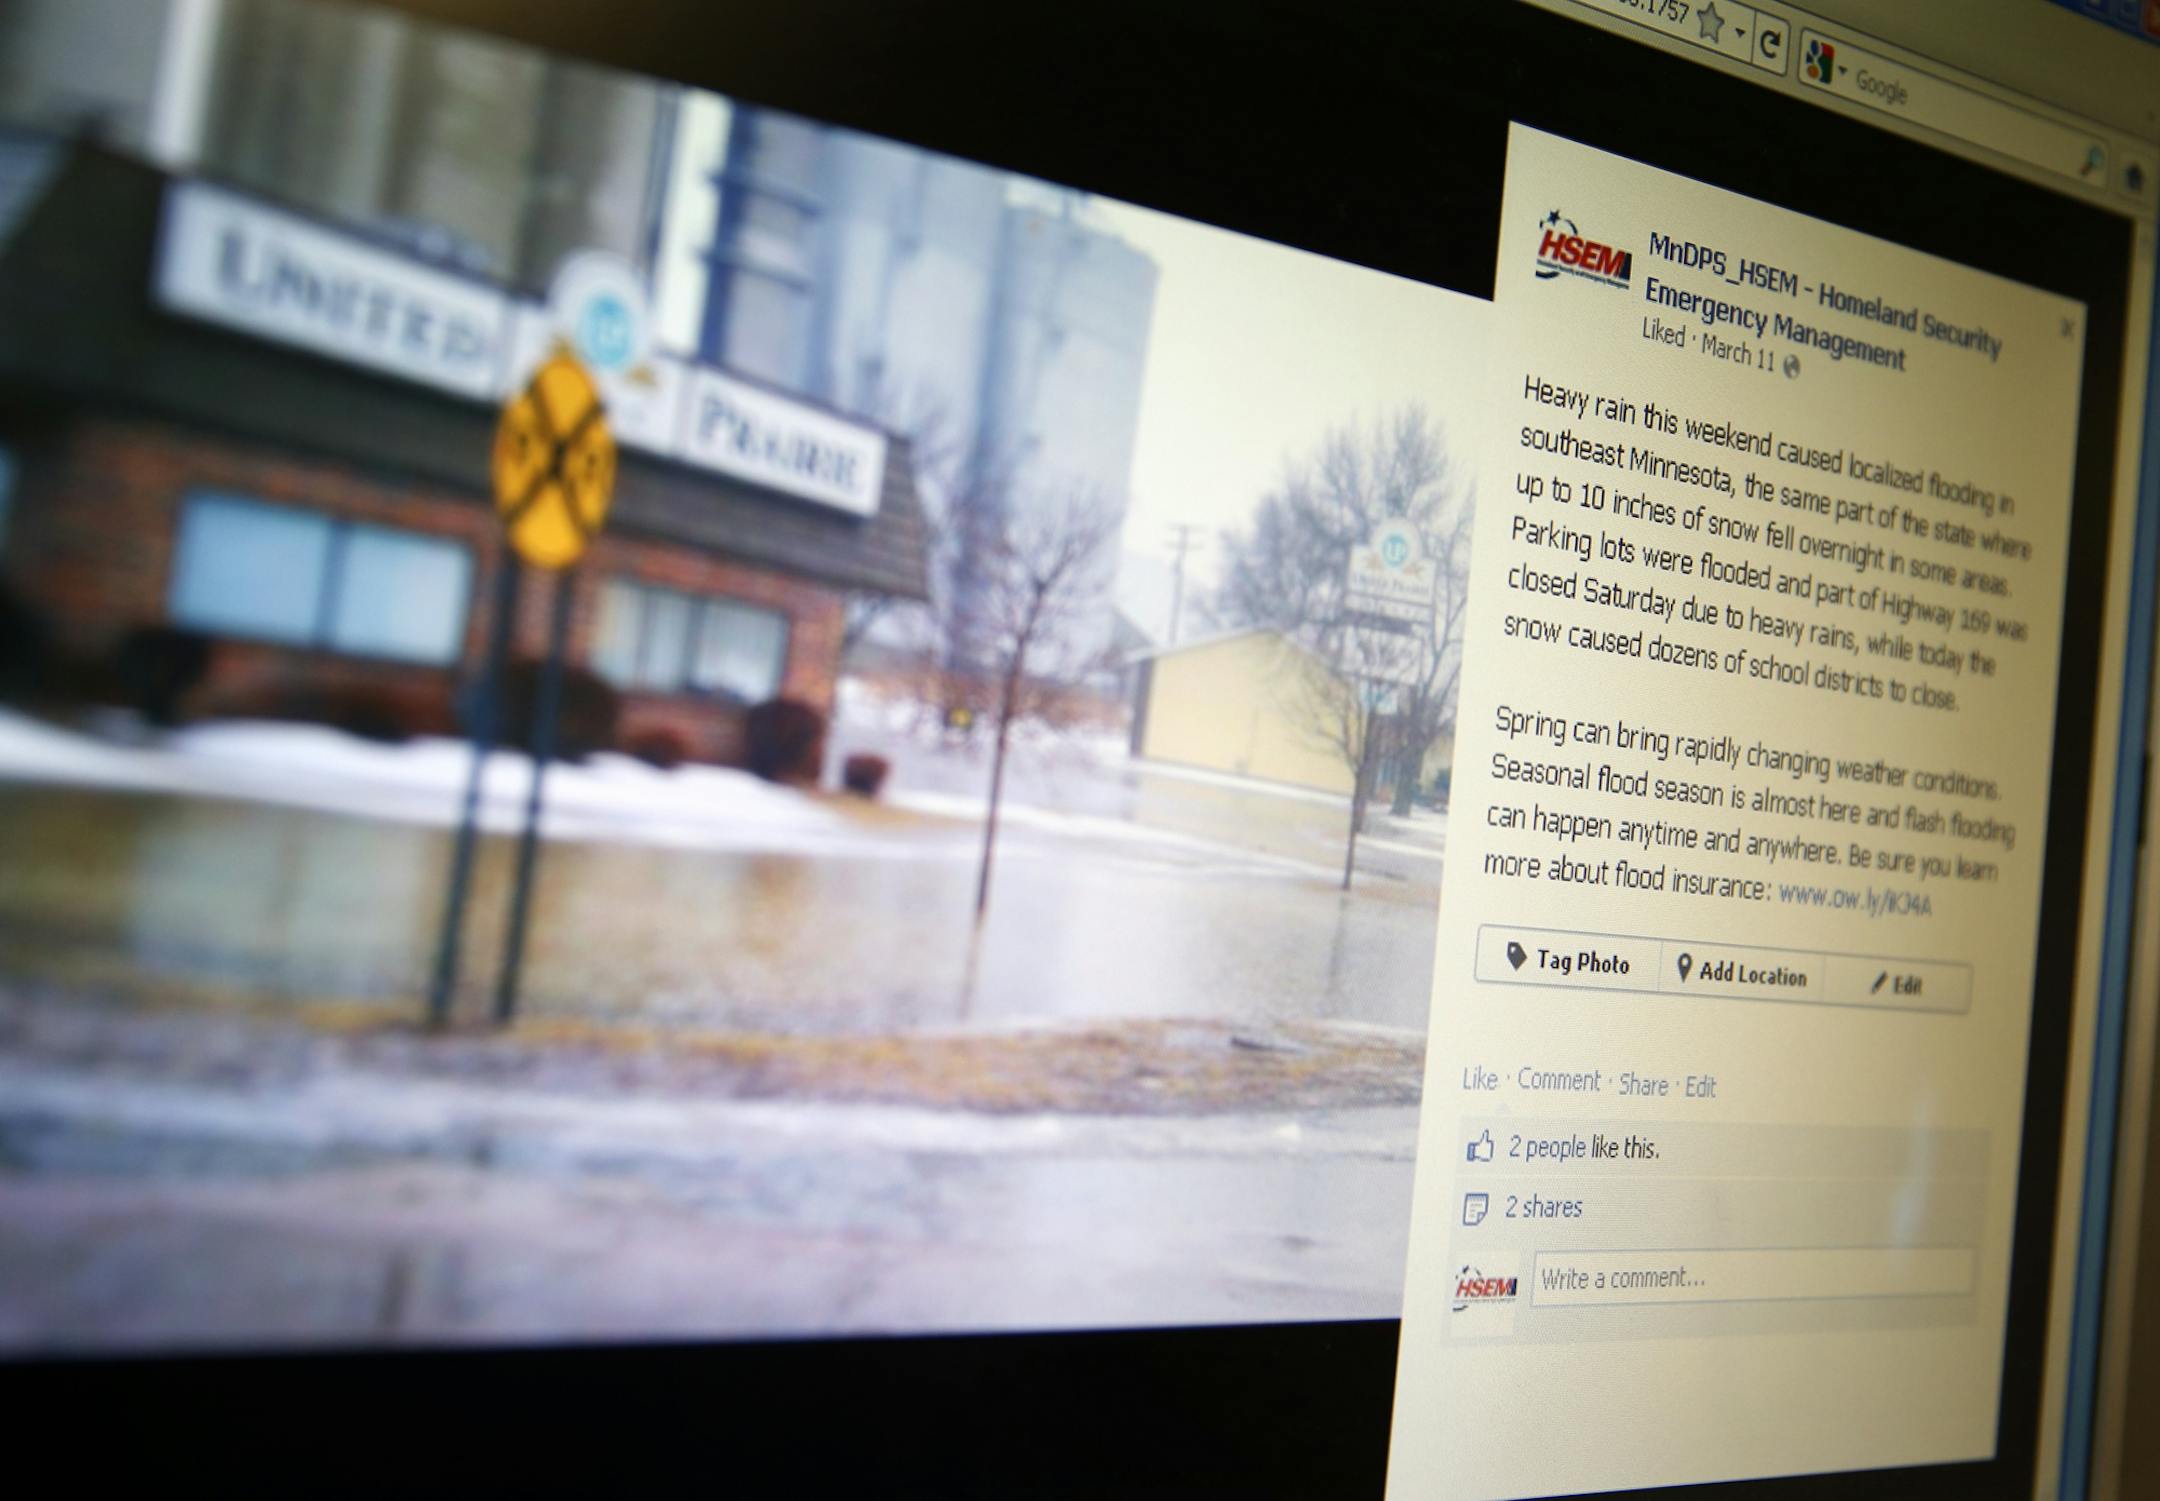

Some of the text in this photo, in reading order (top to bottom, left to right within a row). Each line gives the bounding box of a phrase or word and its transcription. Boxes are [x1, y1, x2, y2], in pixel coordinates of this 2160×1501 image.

[1856, 69, 1908, 104] Google
[1539, 229, 1626, 278] HSEM
[1646, 277, 1906, 371] Emergency Management
[1650, 232, 1798, 297] MnDPS_HSEM
[1819, 283, 1918, 332] Homeland
[1923, 314, 2002, 362] Security
[1643, 317, 1773, 372] Liked March 11
[1525, 375, 2015, 517] Heavy rain this weekend caused localized flooding in
[1521, 427, 2032, 560] southeast Minnesota, the same part of the state where
[1517, 474, 1543, 503] up
[1552, 477, 1571, 503] to
[1581, 484, 1605, 510] 10
[1614, 490, 1676, 525] inches
[1683, 506, 1706, 531] of
[1709, 516, 1759, 542] snow
[1767, 521, 1794, 550] fell
[1800, 535, 1884, 573] overnight
[1890, 554, 1904, 573] in
[1910, 559, 1956, 585] some
[1513, 516, 2027, 641] Parking lots were flooded and part of Highway 169 was
[1509, 563, 1996, 676] closed Saturday due to heavy rains, while today the
[1504, 616, 1959, 712] snow caused dozens of school districts to close.
[1496, 706, 1566, 747] Spring
[1574, 722, 1610, 745] can
[1617, 721, 1669, 761] bring
[1676, 736, 1741, 770] rapidly
[1747, 742, 1830, 783] changing
[1837, 761, 1908, 786] weather
[1492, 753, 2016, 850] Seasonal flood season is almost here and flash flooding
[1488, 804, 1999, 882] can happen anytime and anywhere. Be sure you learn
[1485, 854, 1540, 878] more
[1548, 854, 1609, 885] about
[1616, 860, 1665, 890] flood
[1673, 868, 1771, 901] insurance:
[1538, 950, 1629, 975] Tag Photo
[1700, 961, 1807, 986] Add Location
[1894, 976, 1922, 995] Edit
[1463, 1065, 1717, 1098] Like Comment Share Edit
[1510, 1134, 1659, 1162] 2 people like this.
[1506, 1193, 1583, 1218] 2 shares
[1456, 1278, 1513, 1297] HSEM
[1542, 1266, 1704, 1290] Write a comment...
